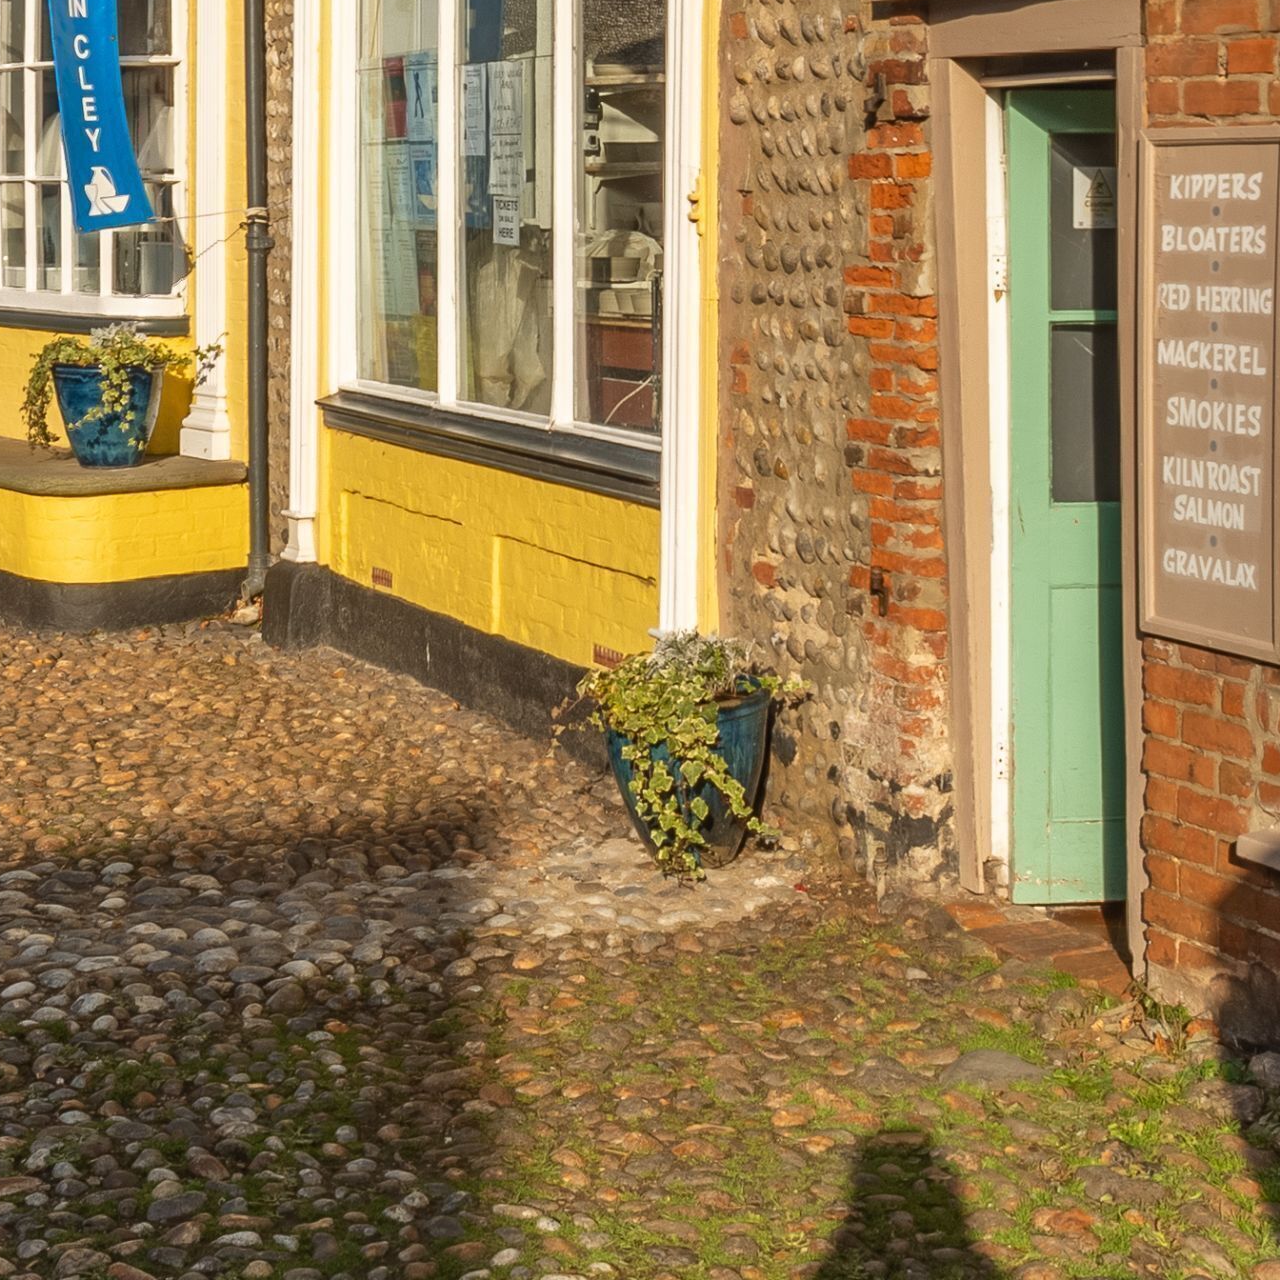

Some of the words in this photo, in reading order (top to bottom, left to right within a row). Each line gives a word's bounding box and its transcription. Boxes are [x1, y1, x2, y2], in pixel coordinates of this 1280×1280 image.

[74, 35, 102, 153] CLEY
[495, 199, 518, 211] TICKETS
[1170, 172, 1264, 201] KIPPERS
[497, 227, 514, 239] HERE
[1161, 224, 1267, 255] BLOATERS
[1158, 283, 1191, 311] RED
[1196, 286, 1273, 315] HERRING
[1157, 339, 1267, 376] MACKEREL
[1166, 396, 1262, 437] SMOKIES
[1162, 456, 1205, 489] KILN
[1206, 461, 1262, 496] ROAST
[1173, 494, 1245, 531] SALMON
[1163, 548, 1257, 590] GRAVALAX
